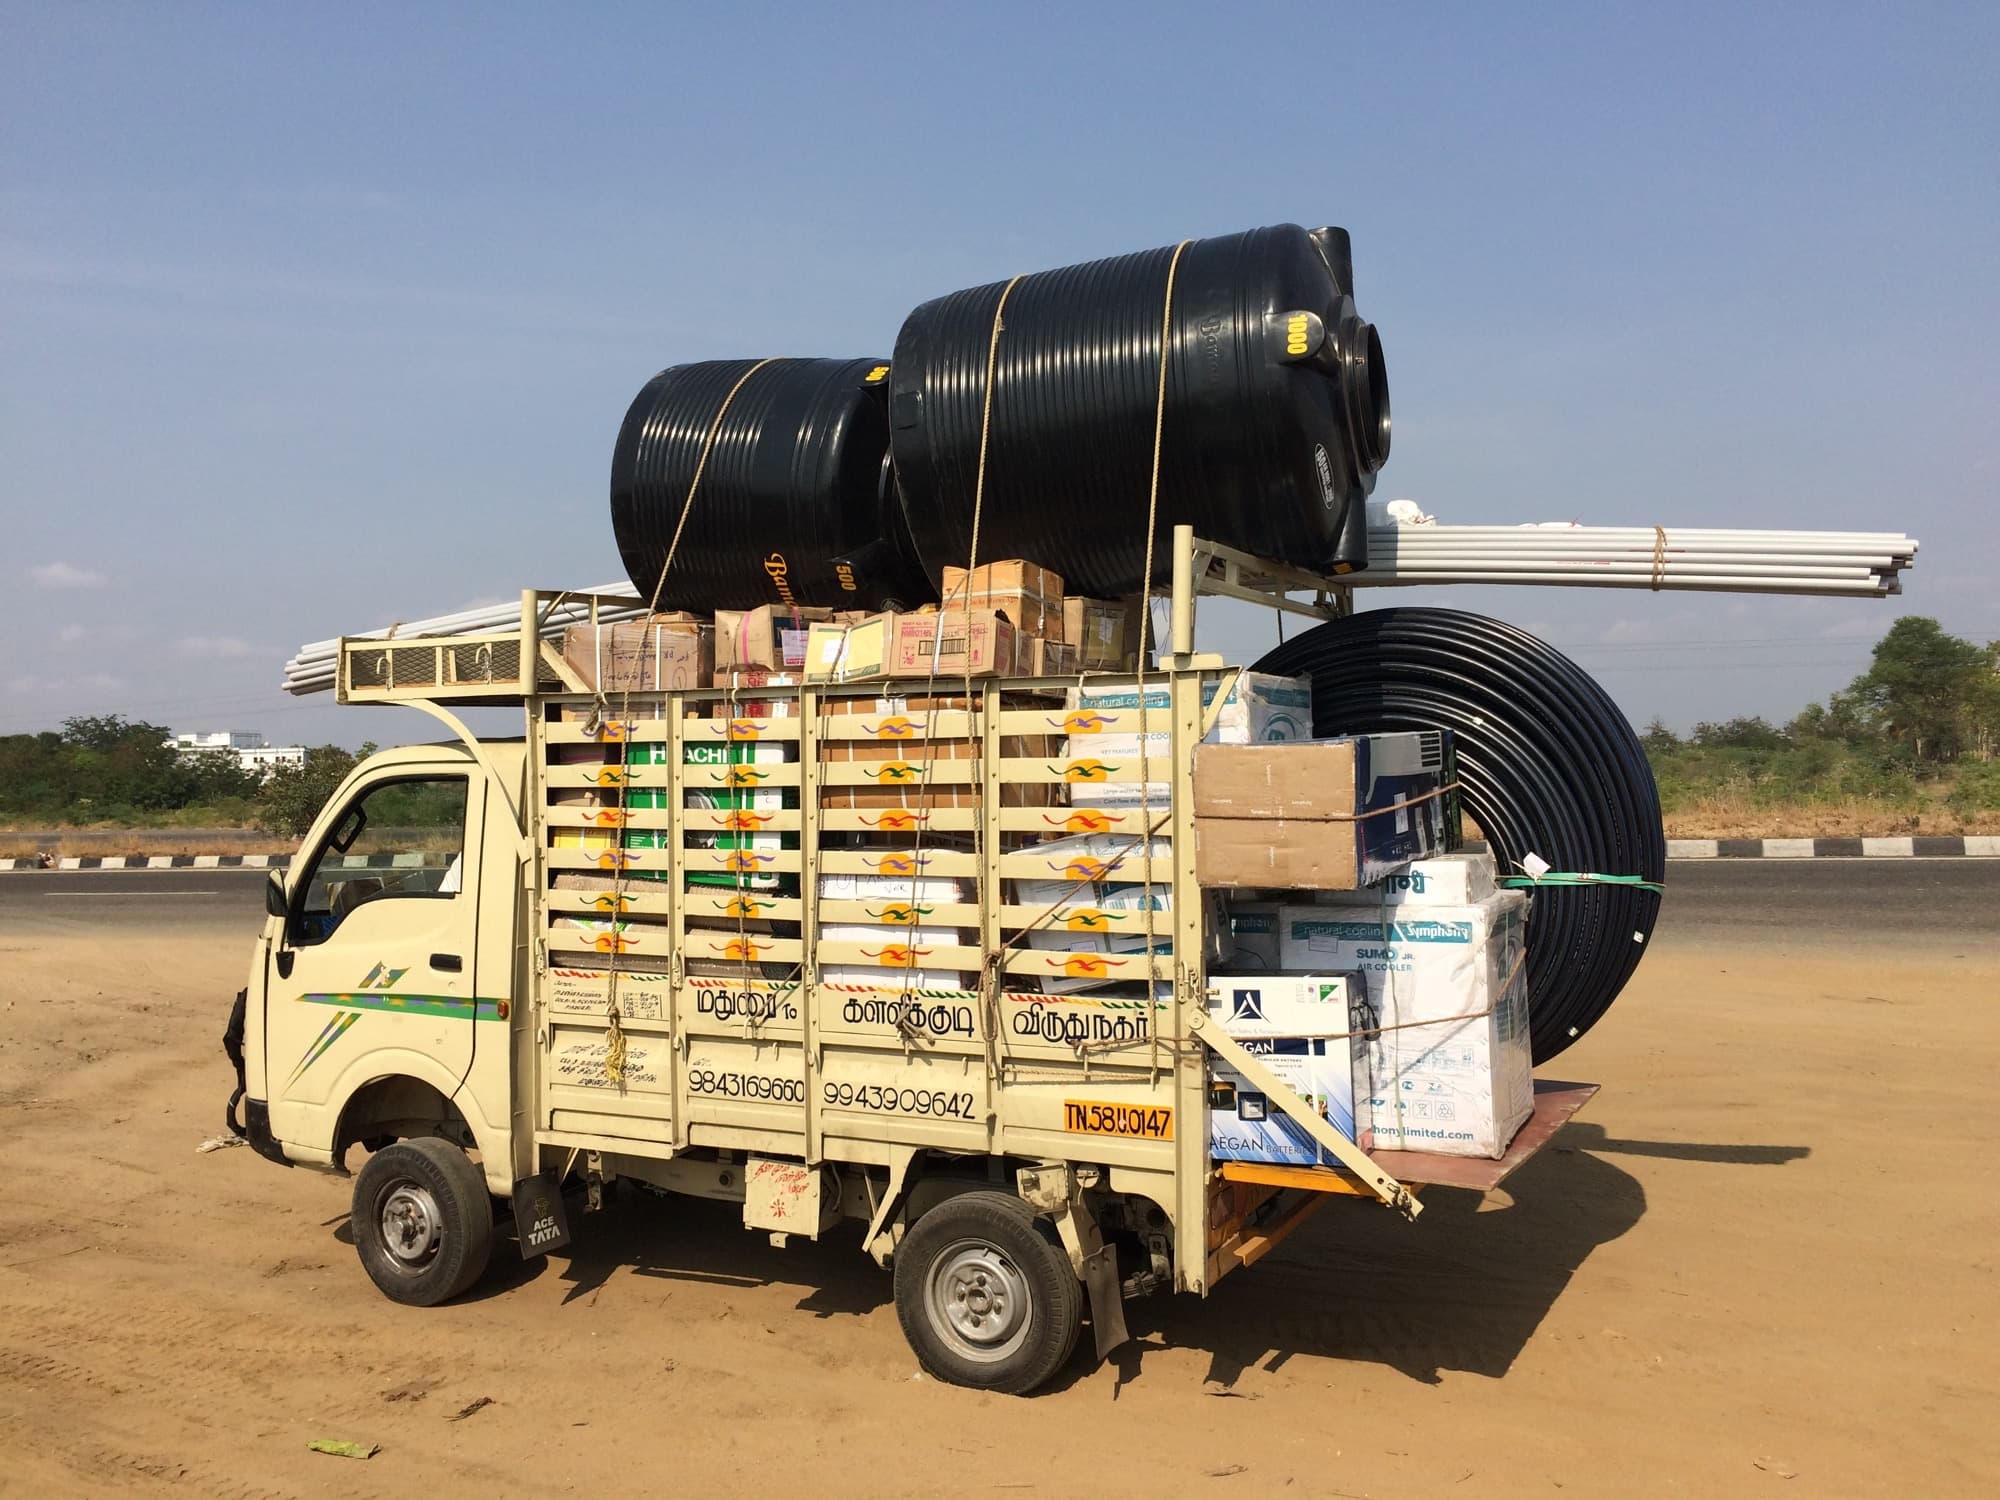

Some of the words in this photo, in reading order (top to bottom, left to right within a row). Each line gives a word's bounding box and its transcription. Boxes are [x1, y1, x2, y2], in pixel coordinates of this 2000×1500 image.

[1287, 313, 1308, 355] 1000
[836, 563, 857, 592] 500
[1126, 694, 1165, 707] coling
[652, 745, 728, 764] HACHI
[1344, 926, 1386, 938] coolin
[1406, 922, 1469, 941] Symphony
[1356, 948, 1398, 961] SUMO
[1357, 963, 1373, 971] AIR
[1375, 963, 1413, 972] COOLER
[782, 1002, 798, 1020] To
[1013, 1002, 1149, 1046] விருதுநகர்
[688, 1069, 805, 1103] 9843169660
[823, 1082, 976, 1120] 9943909642
[1210, 1131, 1264, 1152] AEGAN
[533, 1215, 555, 1232] ACE
[528, 1224, 561, 1247] TATA
